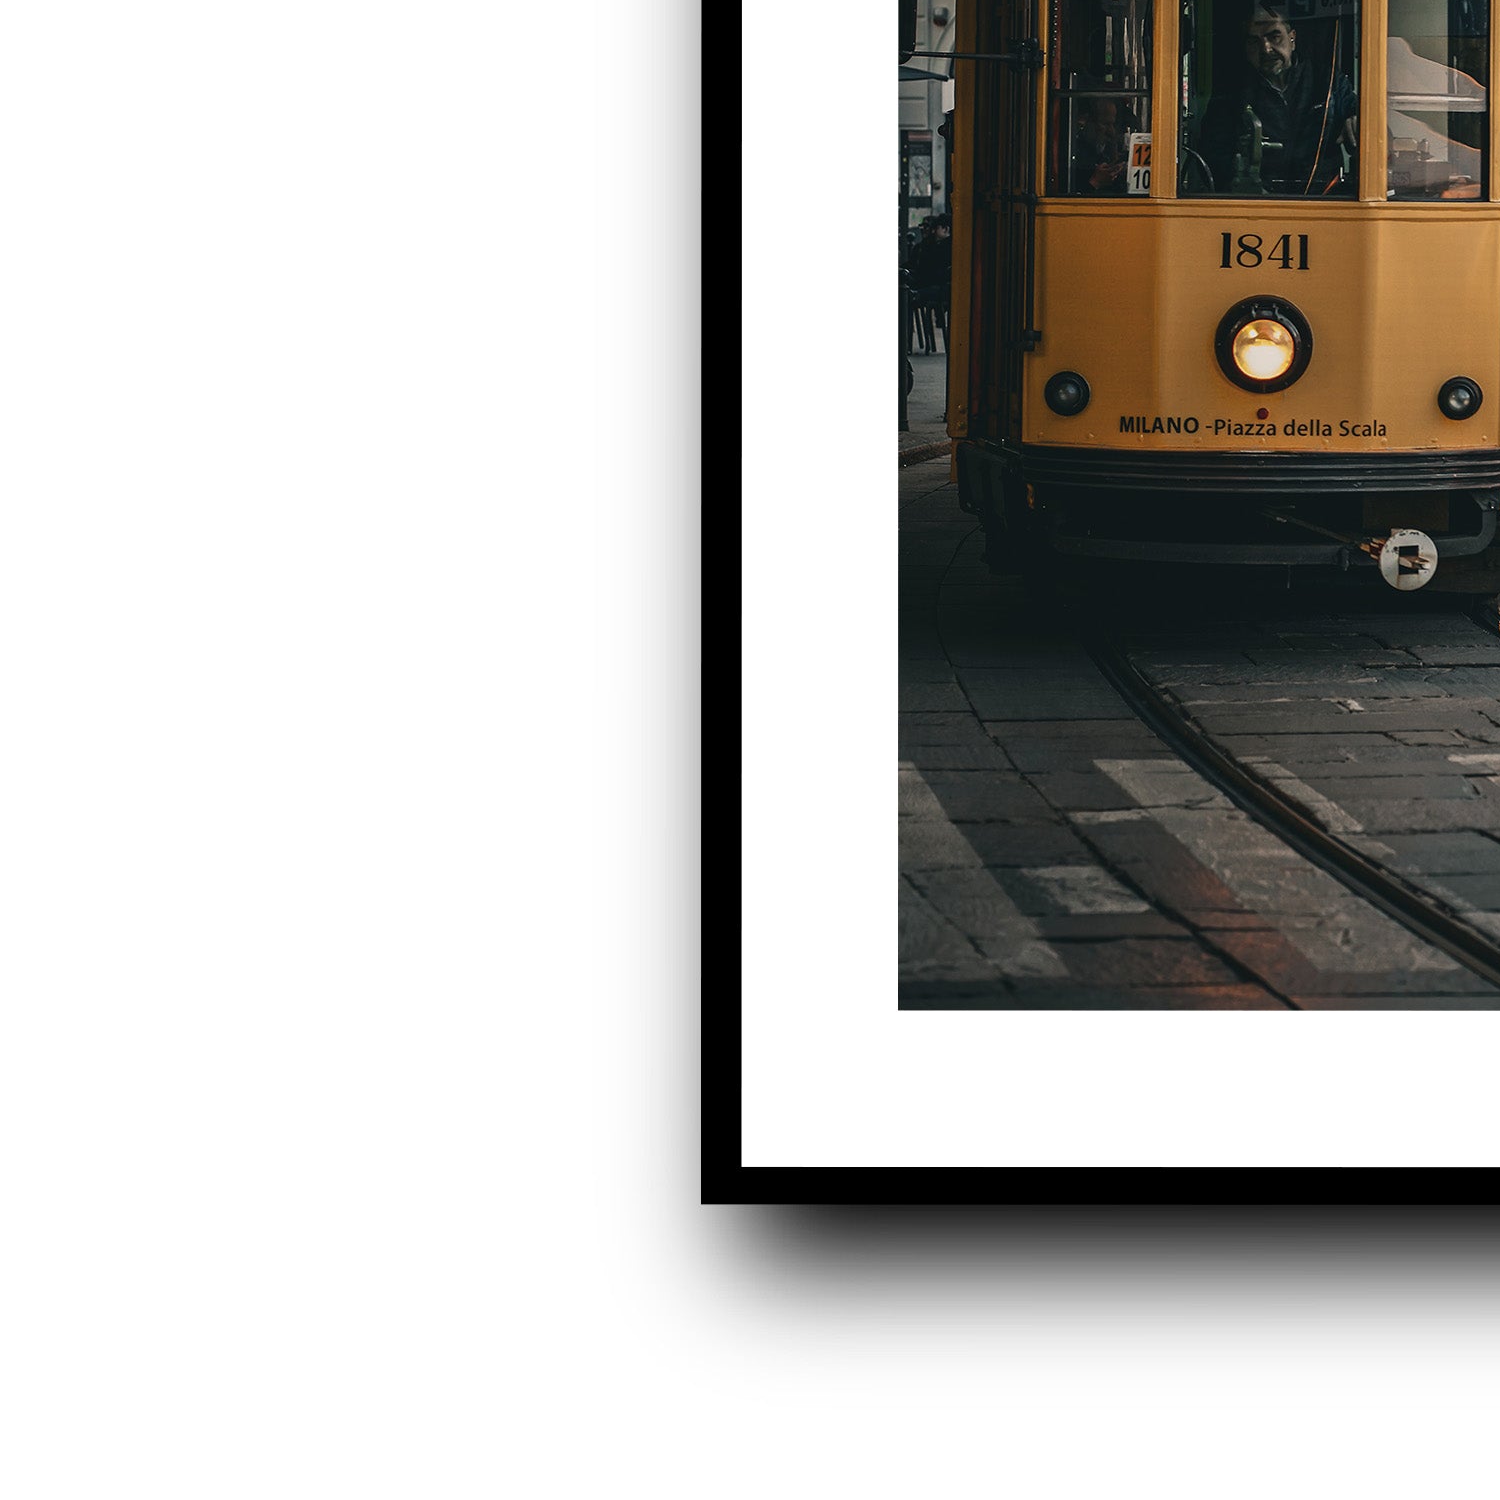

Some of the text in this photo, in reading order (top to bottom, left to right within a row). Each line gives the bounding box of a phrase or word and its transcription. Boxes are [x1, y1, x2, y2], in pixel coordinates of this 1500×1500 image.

[1133, 169, 1151, 190] 10
[1219, 232, 1310, 270] 1841
[1118, 415, 1200, 434] MILANO
[1283, 419, 1333, 437] della
[1338, 419, 1387, 437] Scala
